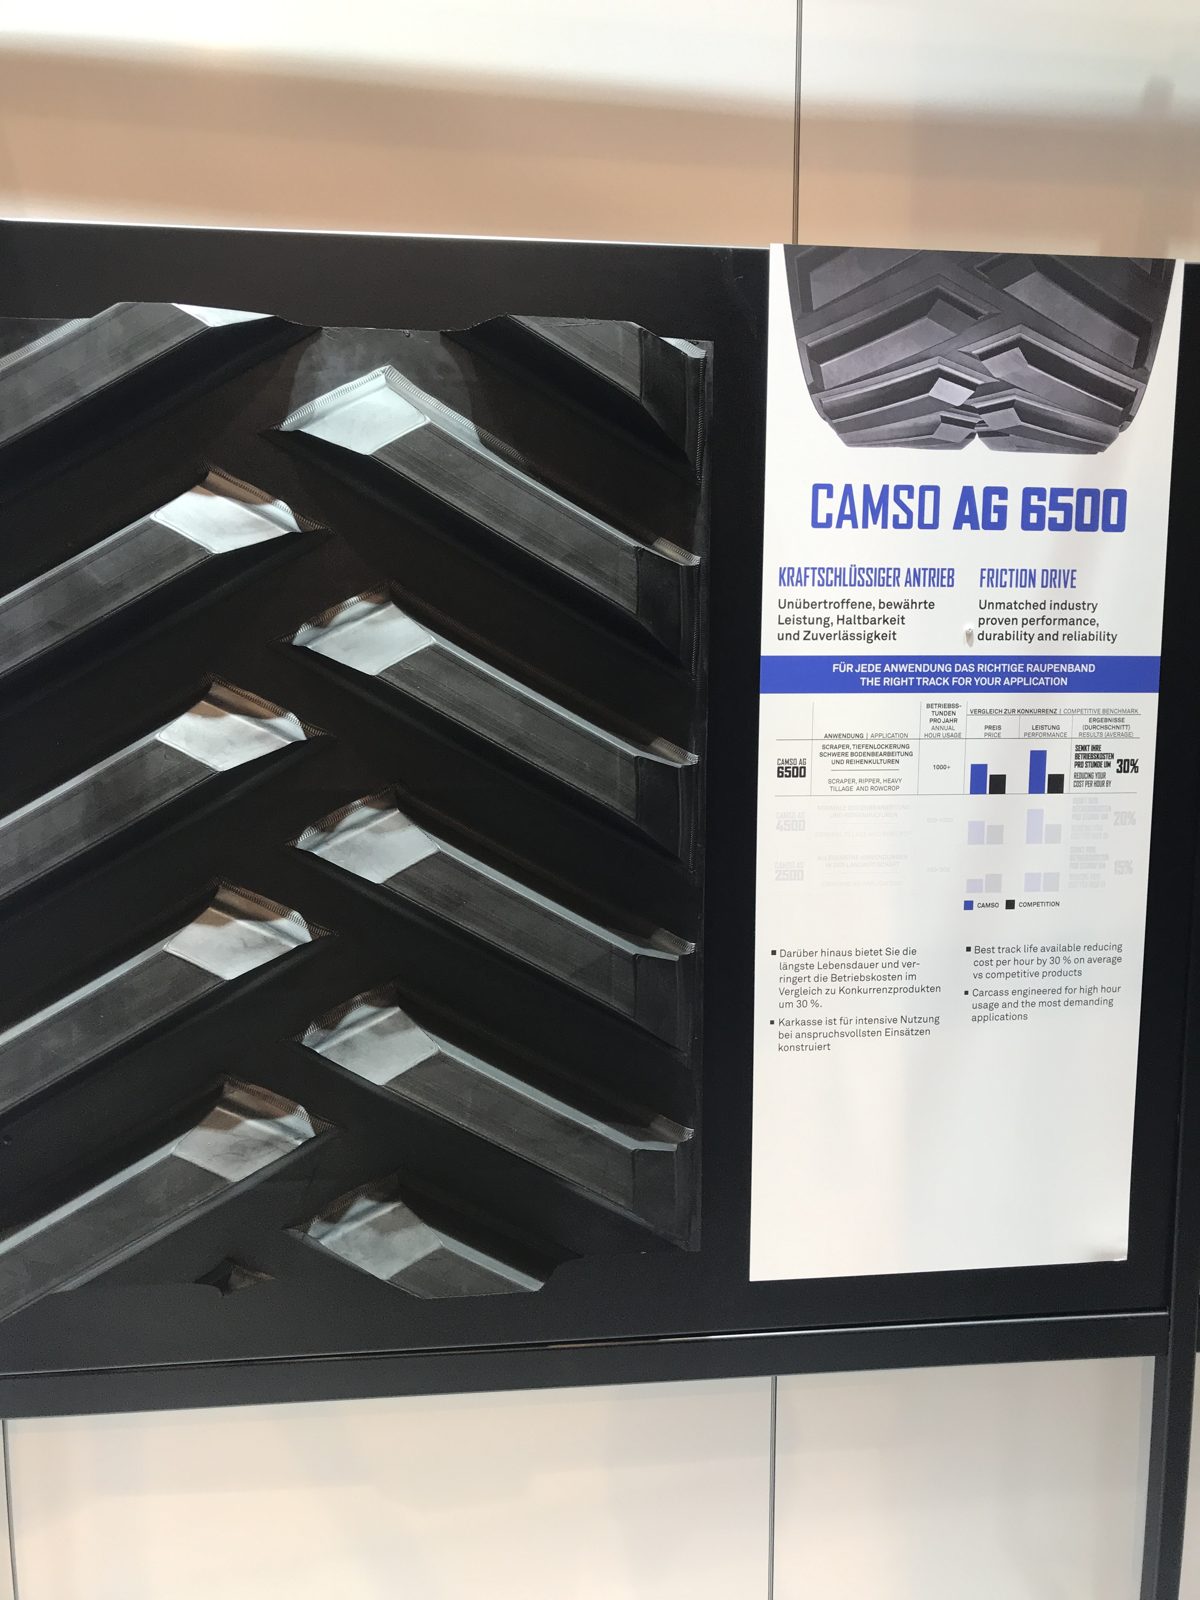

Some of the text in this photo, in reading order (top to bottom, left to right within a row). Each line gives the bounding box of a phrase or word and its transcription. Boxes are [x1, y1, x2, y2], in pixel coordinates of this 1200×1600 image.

[810, 483, 1128, 533] CAMSO AG 6500
[778, 564, 955, 588] KRAFTSCHLÜSSIGER ANTRIEB
[979, 568, 1077, 589] FRICTION DRIVE
[777, 598, 935, 612] Unübertroffene, bewährte
[978, 600, 1098, 614] Unmatched industry
[777, 614, 906, 628] Leistung, Haltbarkeit
[978, 615, 1100, 629] proven performance,
[777, 630, 897, 644] und Zuverlässigkeit
[977, 630, 1118, 644] durability and reliability
[832, 661, 1096, 674] FÜR JEDE ANWENDUNG DAS RICHTIGE RAUPENBAND
[860, 677, 1068, 687] THE RIGHT TRACK FOR YOUR APPLICATION
[777, 758, 807, 766] CAMSO AG
[1116, 759, 1139, 773] 30%
[777, 766, 807, 778] 6500
[775, 820, 806, 831] 4500
[775, 870, 804, 881] 2500
[779, 947, 917, 958] Darüber hinaus bietet Sie die
[974, 942, 1123, 954] Best track life available reducing
[779, 960, 920, 972] längste Lebensdauer und ver-
[973, 955, 1123, 969] cost per hour by 30 % on average
[779, 972, 917, 986] ringert die Betriebskosten im
[973, 968, 1082, 981] vs competitive products
[778, 986, 823, 999] Vergleich
[838, 984, 941, 997] Konkurrenzprodukten
[972, 984, 1121, 999] Carcass engineered for high hour
[778, 998, 823, 1009] um 30 %.
[971, 997, 1114, 1012] usage and the most demanding
[778, 1014, 941, 1027] Karkasse ist für intensive Nutzung
[971, 1011, 1028, 1024] applications
[778, 1026, 931, 1041] bei anspruchsvollsten Einsätzen
[777, 1042, 831, 1052] konstruiert
